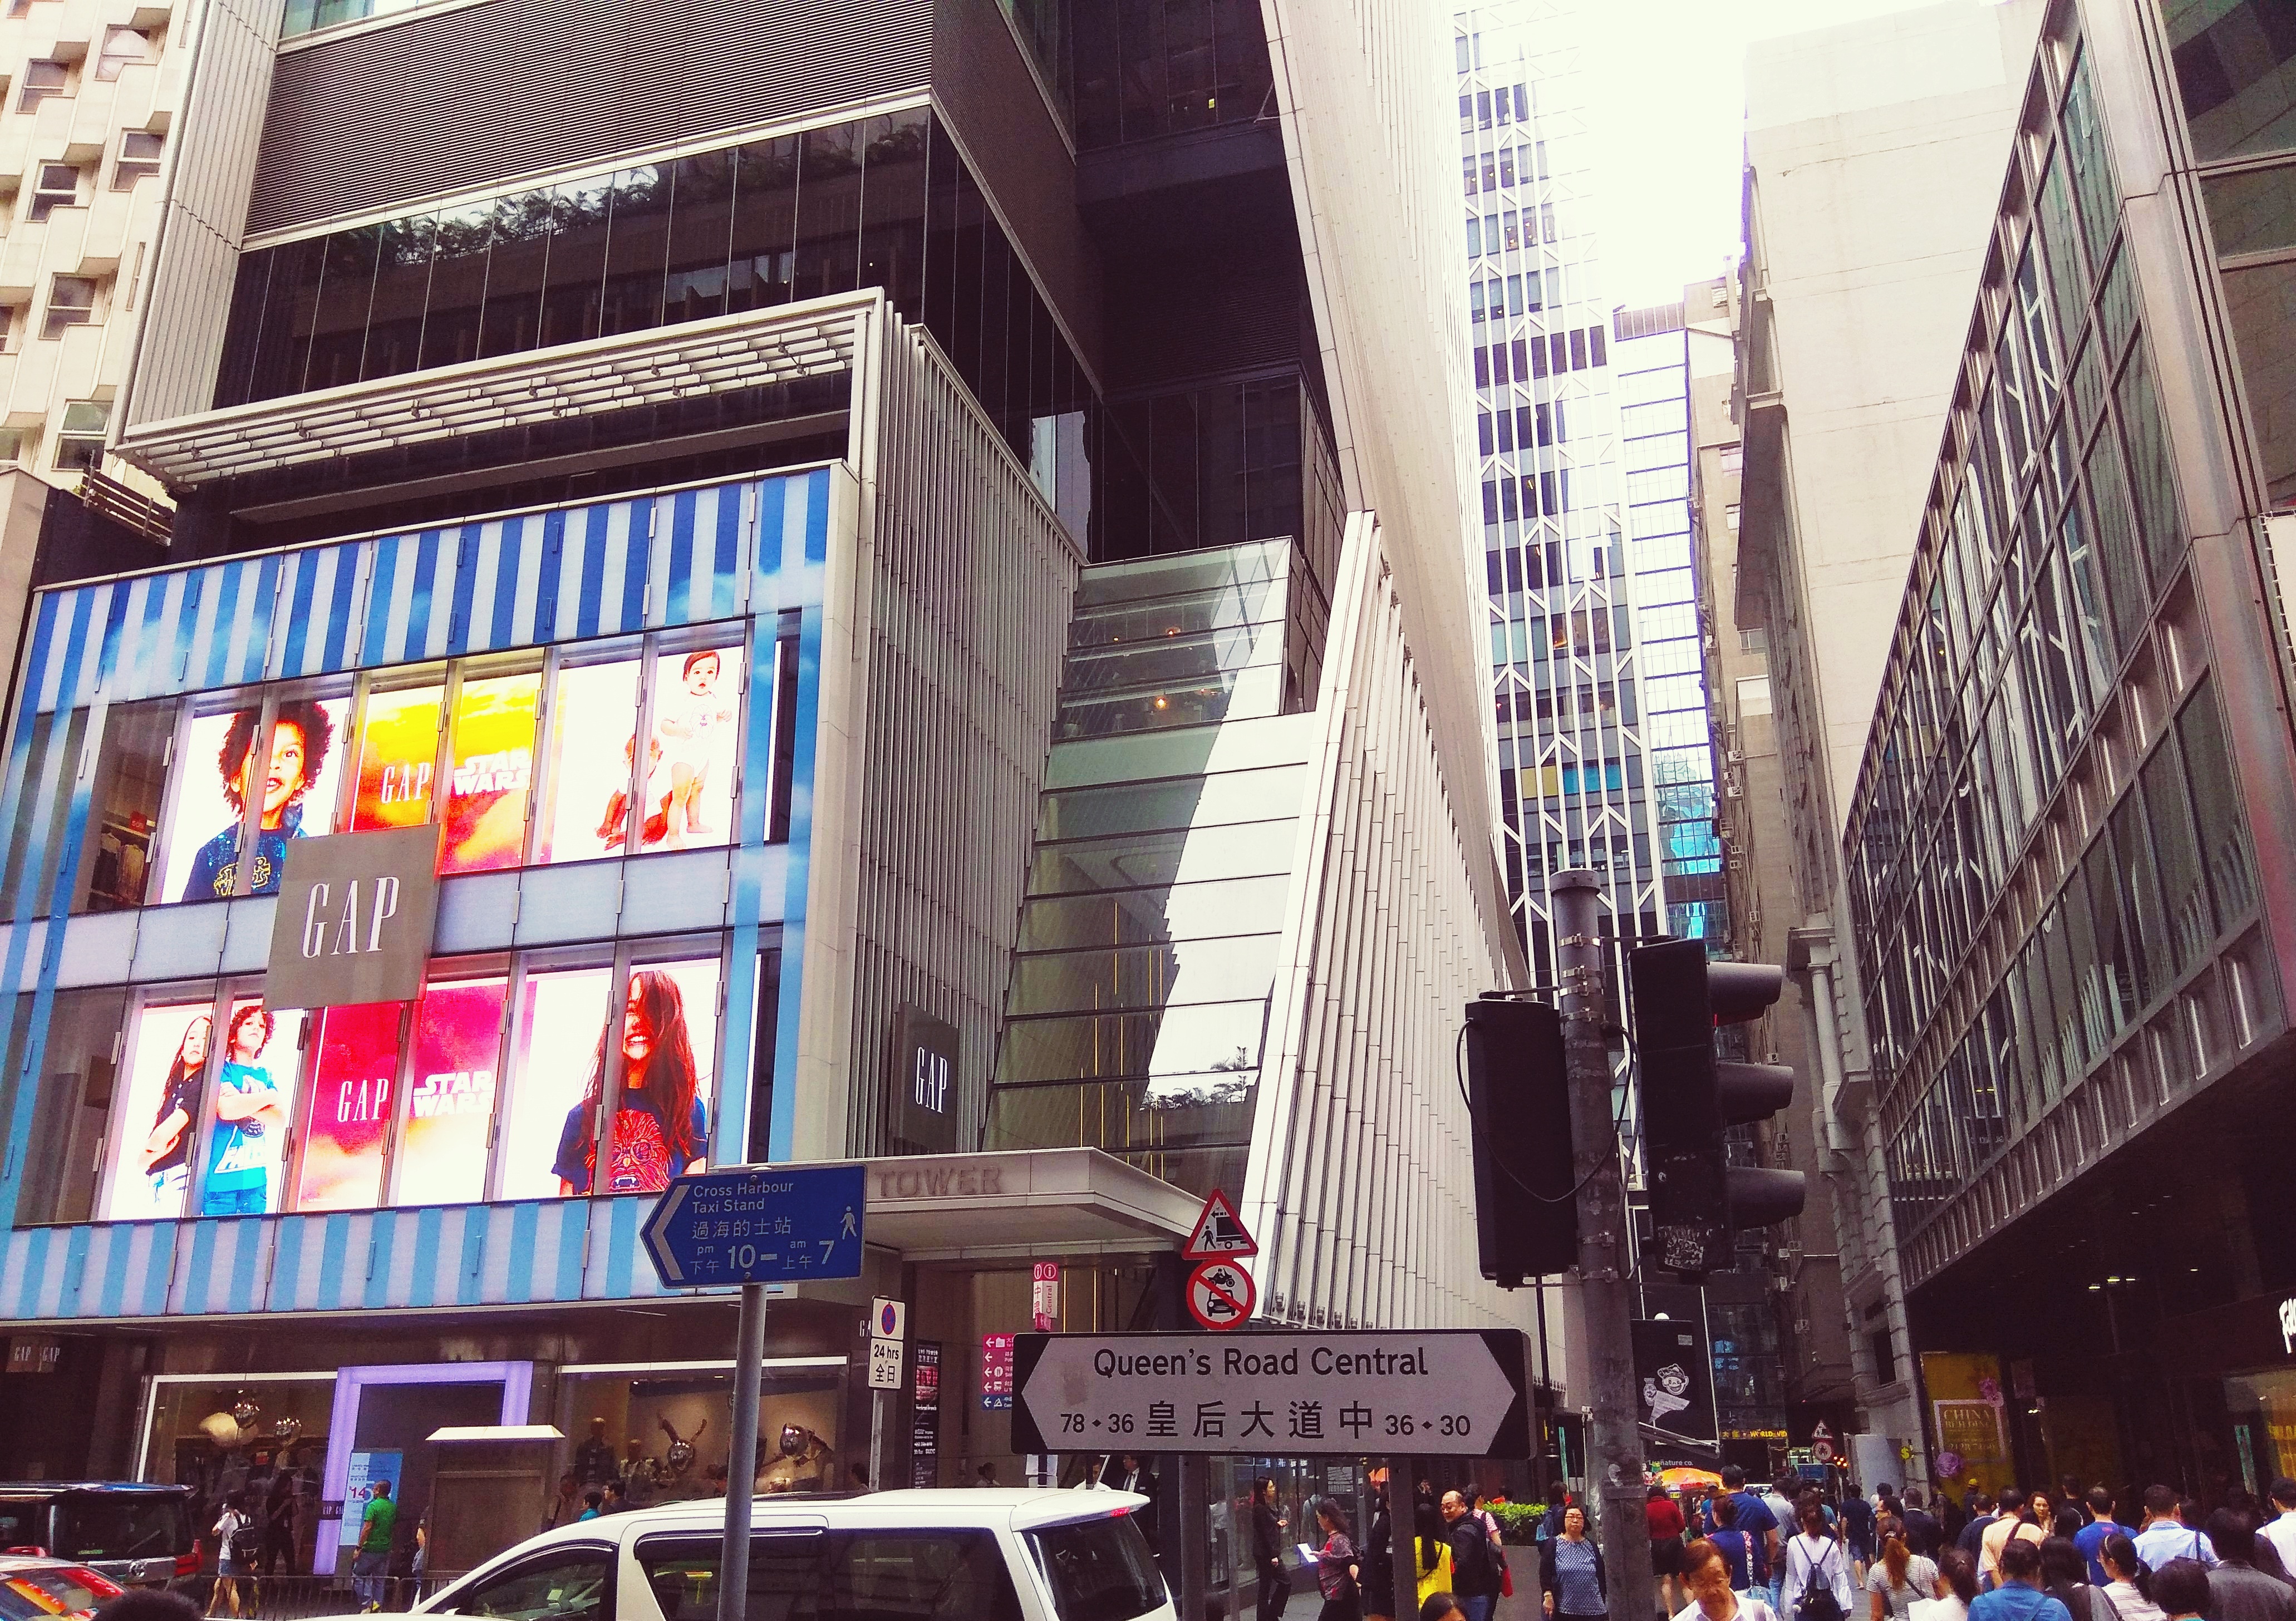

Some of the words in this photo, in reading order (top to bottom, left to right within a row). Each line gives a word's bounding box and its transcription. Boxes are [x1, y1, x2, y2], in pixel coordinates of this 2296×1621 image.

[454, 751, 532, 776] STAR
[380, 762, 431, 804] GAP
[454, 769, 532, 795] WARS
[302, 876, 400, 959] GAP
[413, 1070, 496, 1096] STAR
[916, 1047, 947, 1113] GAP
[337, 1078, 389, 1122] GAP
[413, 1091, 495, 1117] WARS
[694, 1185, 732, 1198] Cross
[737, 1181, 794, 1196] Harbour
[874, 1166, 1002, 1197] TOWER
[692, 1201, 719, 1214] Taxi
[724, 1198, 765, 1212] Stand
[692, 1216, 791, 1240] 過海的士站
[690, 1260, 719, 1275] 下午
[782, 1254, 813, 1270] 上午
[697, 1245, 714, 1255] pm
[819, 1240, 834, 1264] 7
[859, 1320, 871, 1337] GA
[14, 1347, 31, 1361] GAP
[874, 1344, 885, 1358] 24
[887, 1346, 899, 1360] hrs
[1094, 1348, 1211, 1377] Queen's
[1224, 1348, 1299, 1376] Road
[1310, 1347, 1428, 1376] Central
[875, 1363, 895, 1383] 全日
[1060, 1414, 1085, 1433] 78
[1108, 1414, 1134, 1433] 36
[1145, 1400, 1374, 1439] 皇后大道中
[1385, 1416, 1414, 1436] 36
[1440, 1416, 1471, 1436] 30
[1944, 1410, 1991, 1420] CHINA
